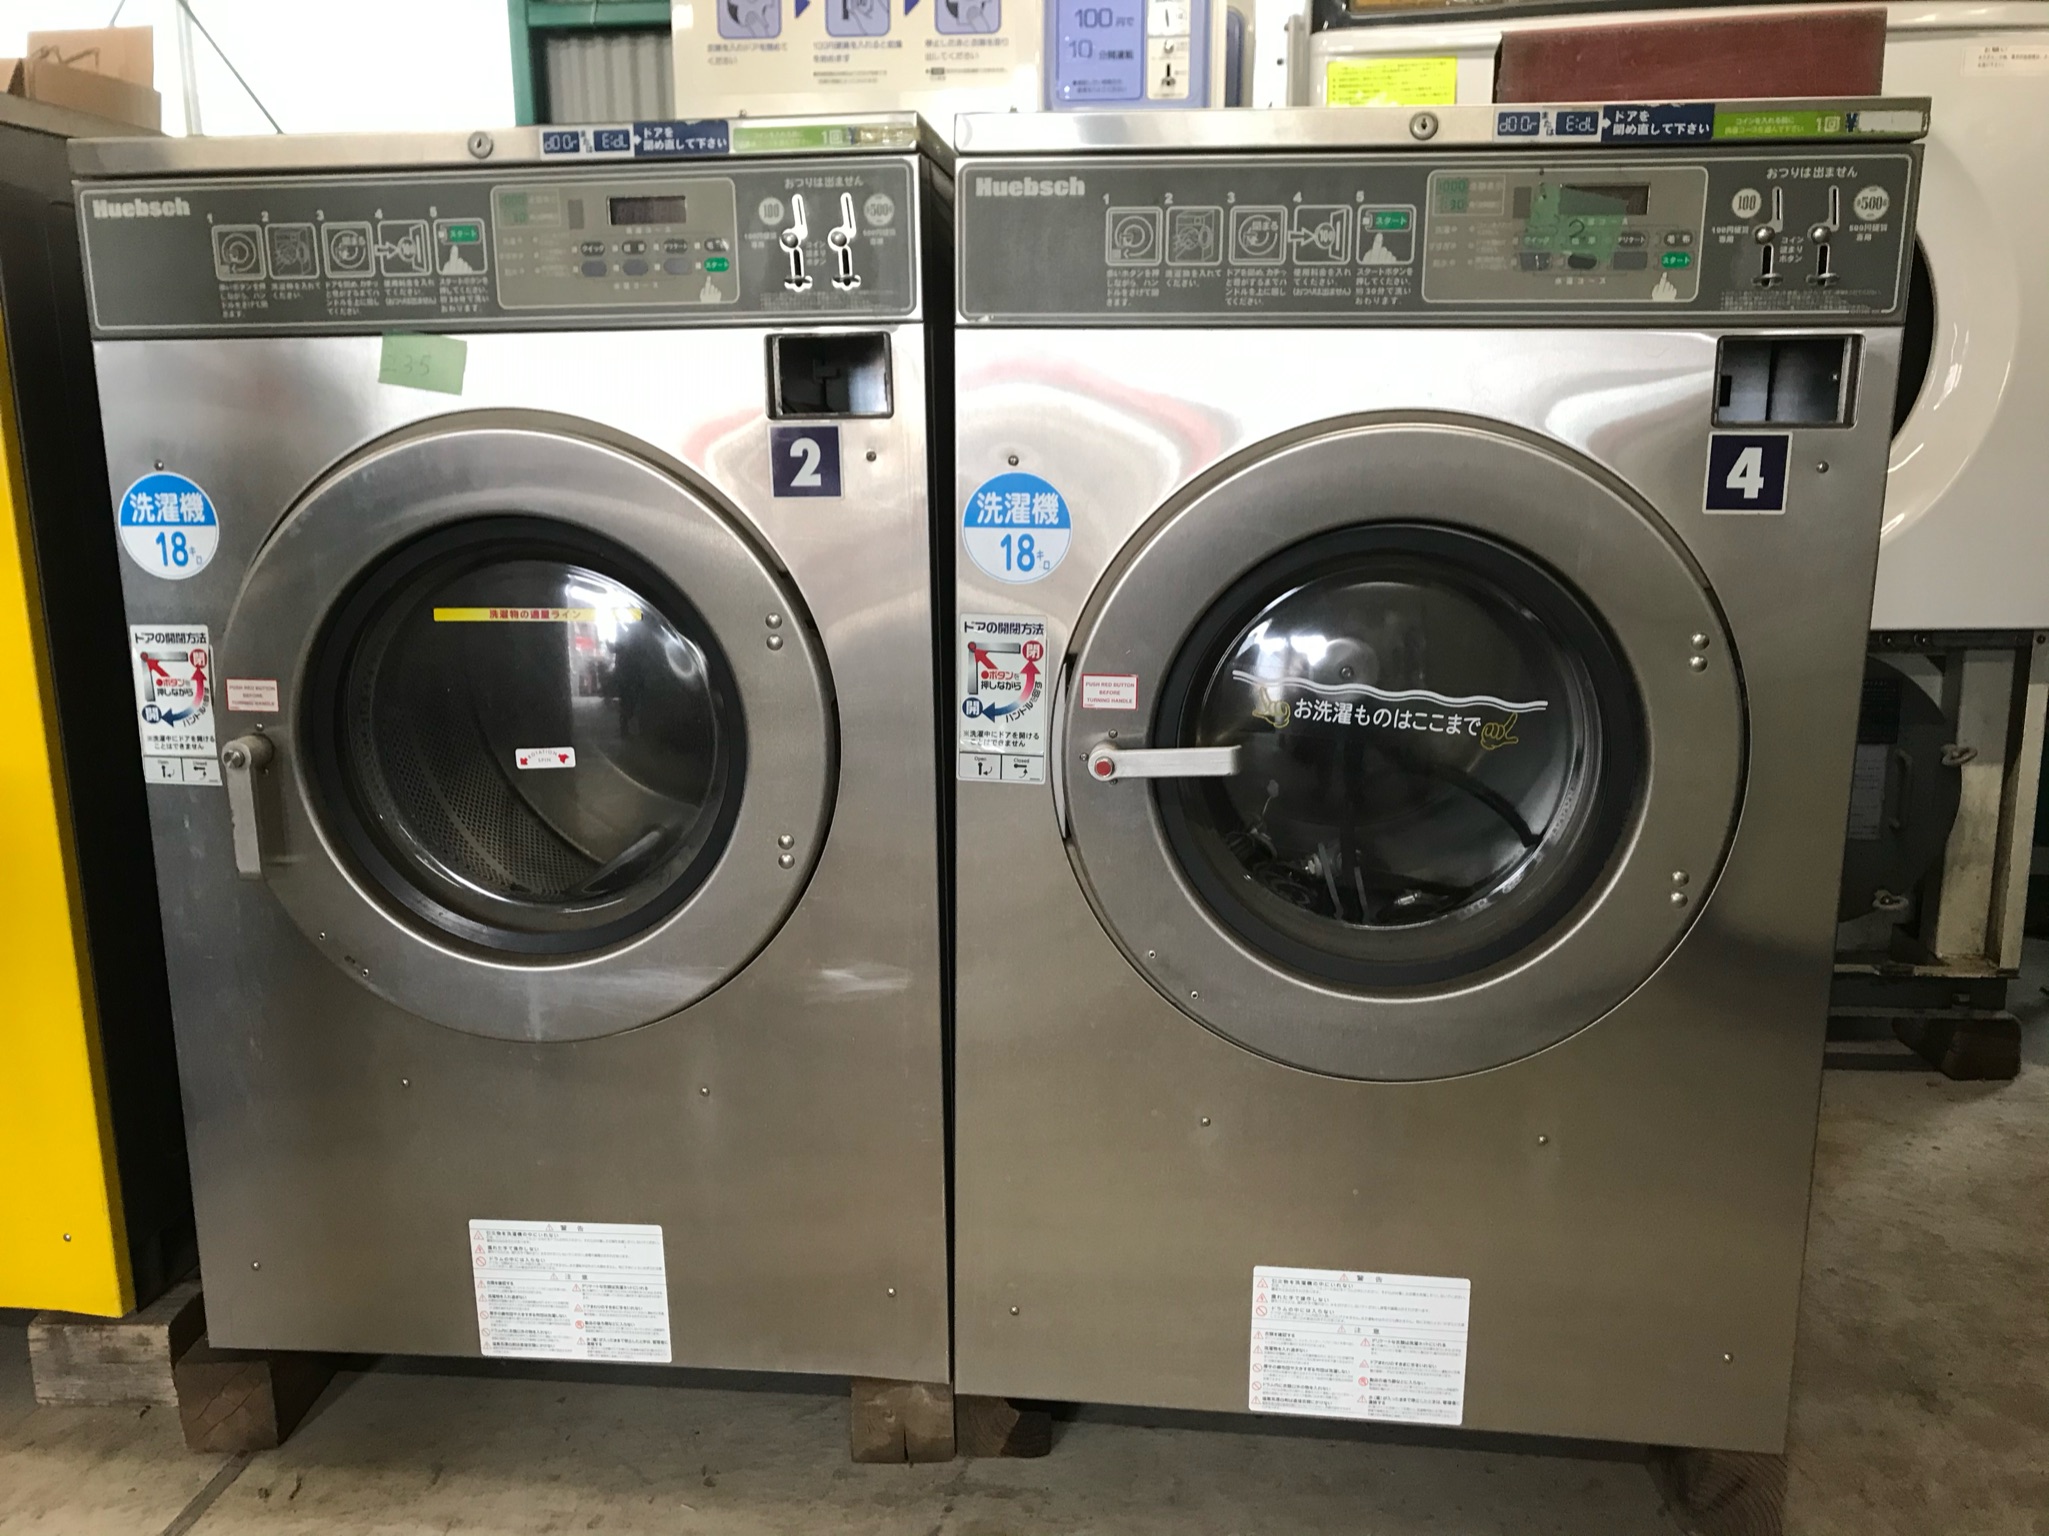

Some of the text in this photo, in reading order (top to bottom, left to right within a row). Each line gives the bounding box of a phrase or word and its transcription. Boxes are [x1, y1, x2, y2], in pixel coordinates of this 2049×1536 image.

[1614, 110, 1650, 123] ドアを
[1612, 123, 1710, 137] 閉め直して下さい
[1816, 115, 1841, 133] 1回
[643, 127, 673, 139] ドアを
[1766, 166, 1858, 179] おつりは出ません
[975, 177, 1086, 198] Huebsch
[1102, 193, 1110, 205] 1
[1164, 193, 1174, 204] 2
[1227, 191, 1236, 203] 3
[1293, 191, 1303, 203] 4
[1355, 190, 1365, 203] 5
[1737, 195, 1757, 211] 100
[1860, 196, 1883, 211] 500
[93, 197, 191, 220] Huebsch
[789, 436, 822, 487] 2
[1725, 446, 1765, 499] 4
[129, 491, 206, 524] 洗濯機
[976, 491, 1060, 526] 洗濯機
[489, 609, 581, 619] 洗濯物の適量ライン
[964, 621, 1045, 636] ドアの開閉方法
[134, 632, 208, 645] ドアの開閉方法
[1026, 643, 1041, 659] 閉
[980, 680, 1022, 691] 押しながら
[965, 700, 980, 716] 開
[1293, 697, 1482, 737] お洗濯ものはここまで
[970, 738, 1026, 748] ことはできません
